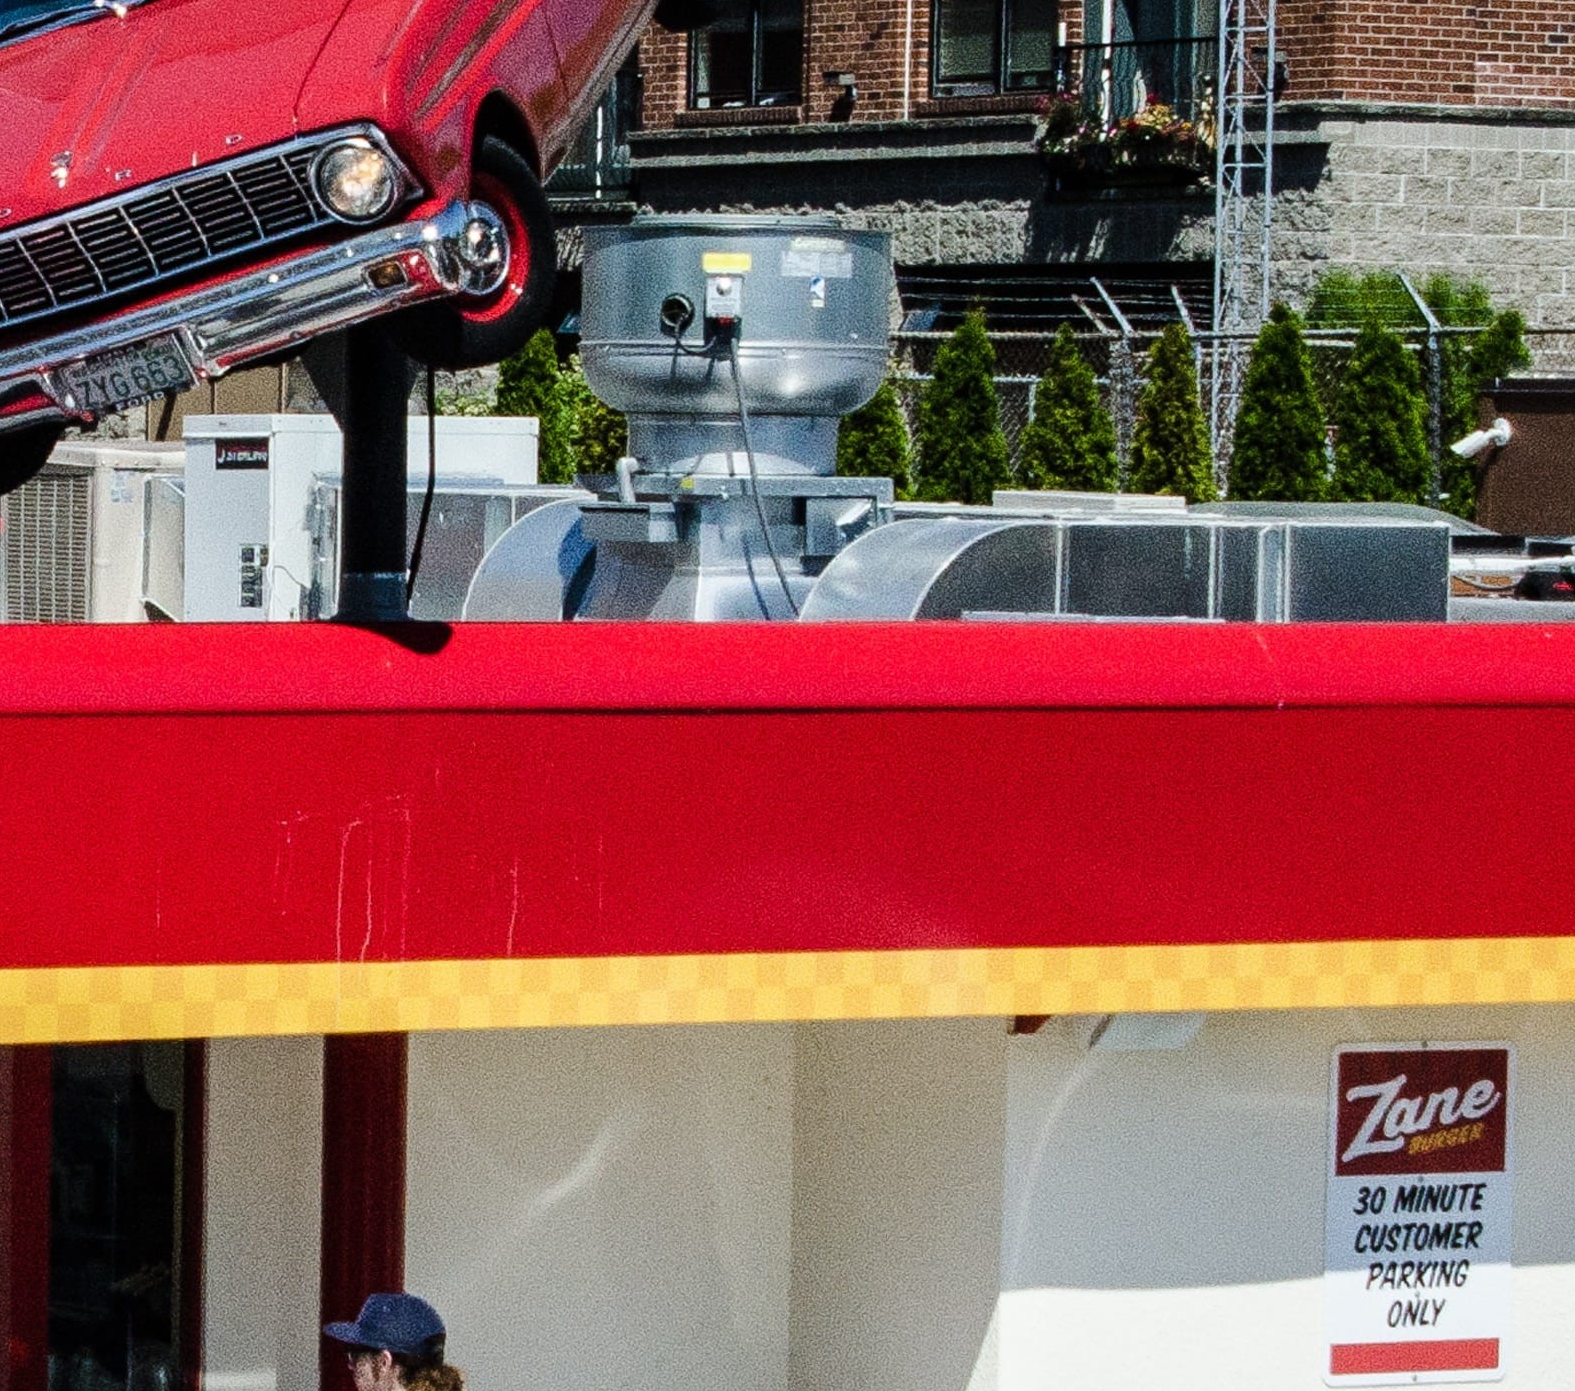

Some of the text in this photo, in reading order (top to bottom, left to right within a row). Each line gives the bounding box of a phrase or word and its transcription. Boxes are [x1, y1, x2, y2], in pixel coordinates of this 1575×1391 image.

[1341, 1074, 1502, 1162] Zane
[1408, 1122, 1485, 1155] BURGER
[1353, 1183, 1487, 1215] 30 MINUTE
[1354, 1220, 1483, 1253] CUSTOMER
[1366, 1259, 1470, 1290] PARKING
[1387, 1298, 1446, 1328] ONLY
